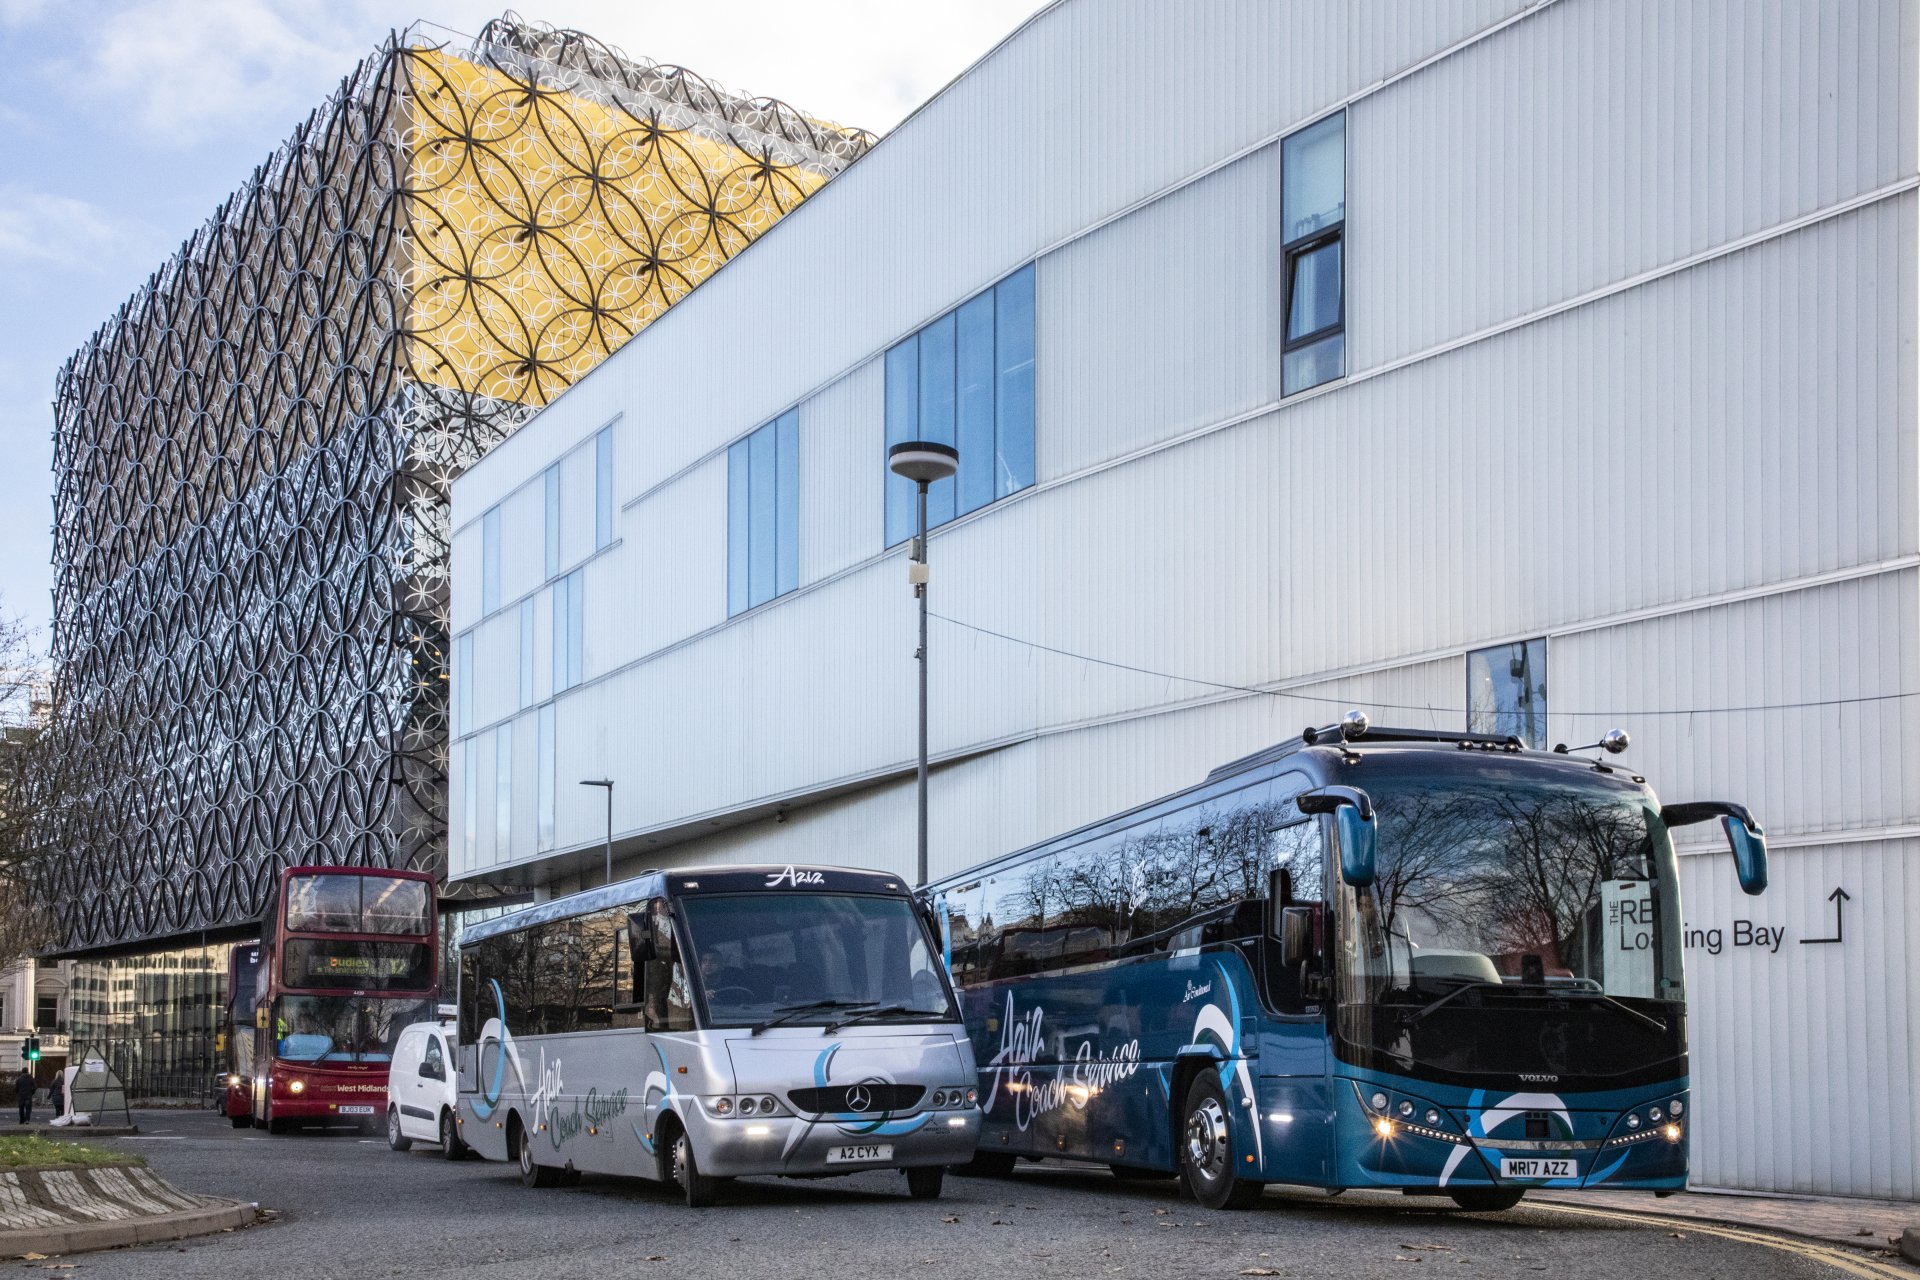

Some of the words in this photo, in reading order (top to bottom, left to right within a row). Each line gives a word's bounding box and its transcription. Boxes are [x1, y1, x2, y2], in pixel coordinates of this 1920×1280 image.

[765, 864, 825, 887] Aziz
[1609, 900, 1619, 926] THE
[1733, 919, 1785, 954] Bay
[337, 1084, 356, 1092] West
[1016, 1053, 1067, 1132] Coach
[1071, 1039, 1140, 1109] Service
[1518, 1074, 1559, 1082] VOLVO
[551, 1106, 582, 1151] Coach
[585, 1087, 627, 1128] Service
[840, 1147, 855, 1160] A2
[857, 1145, 879, 1158] CYX
[1509, 1161, 1539, 1176] MR17
[1543, 1161, 1569, 1176] AZZ
